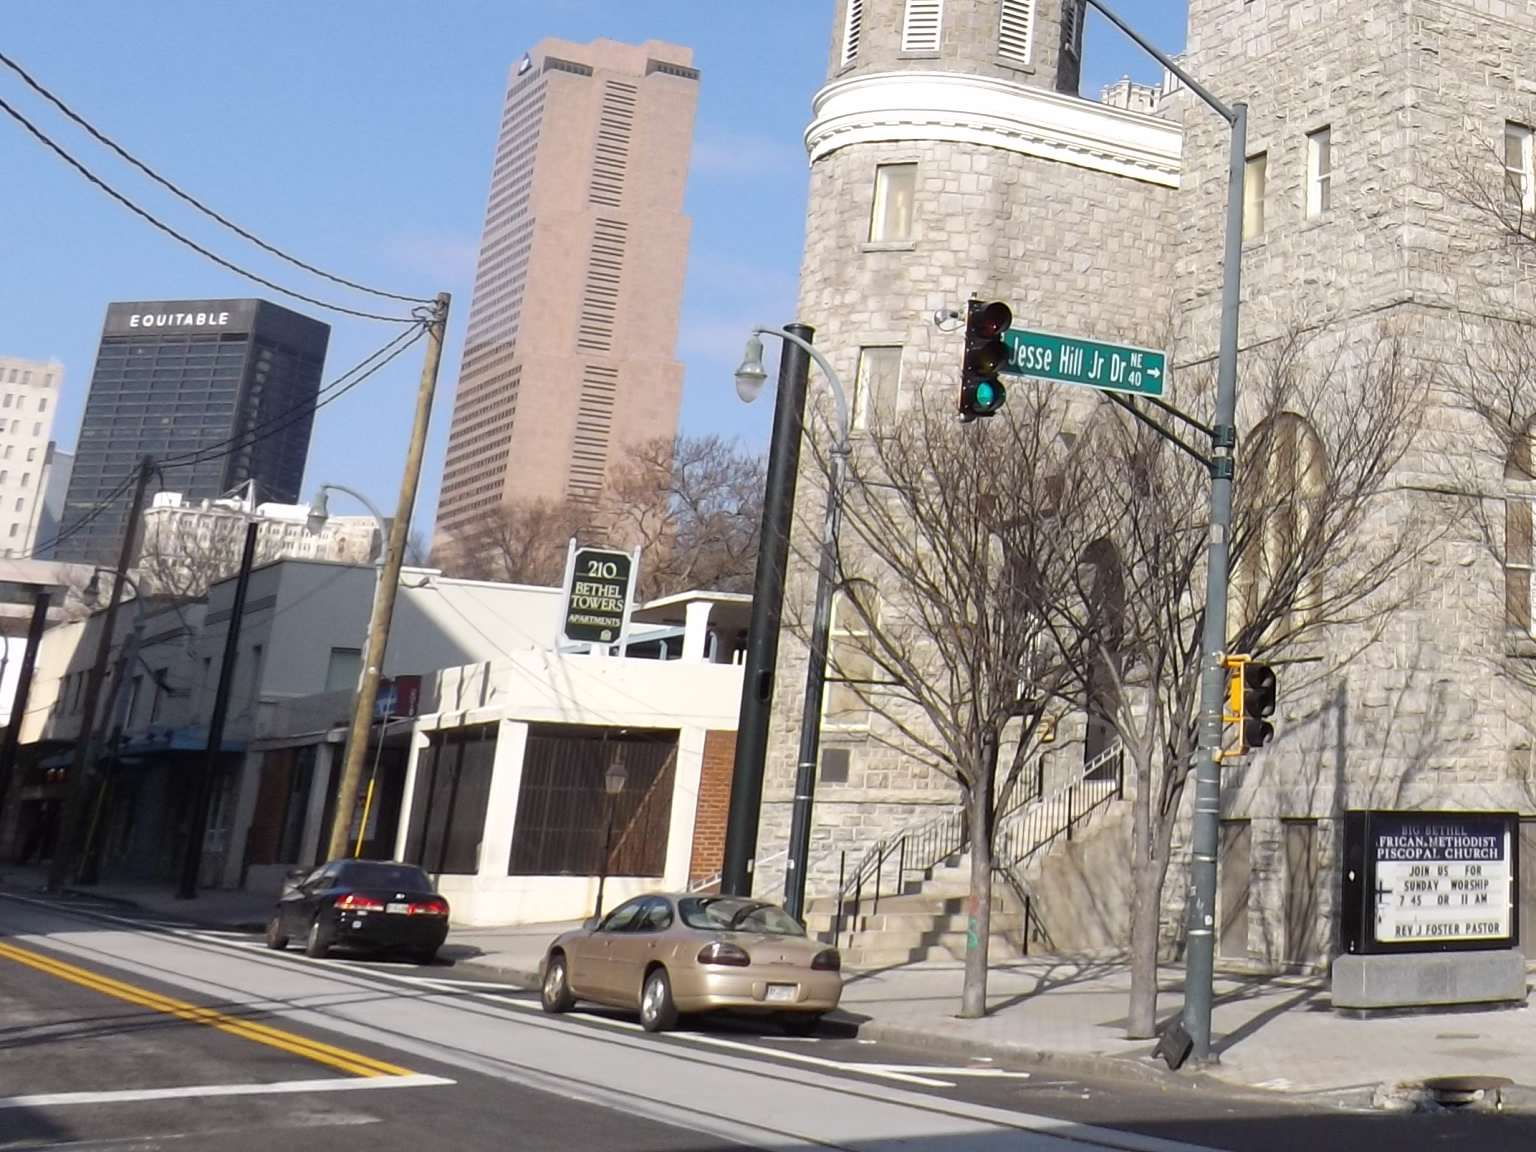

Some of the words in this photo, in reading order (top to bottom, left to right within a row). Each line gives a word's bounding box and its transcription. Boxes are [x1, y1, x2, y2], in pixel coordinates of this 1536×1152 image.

[130, 312, 229, 327] EQUITABLE
[1008, 336, 1052, 371] Jesse
[1058, 344, 1084, 377] Hill
[1087, 350, 1105, 380] Jr
[1110, 353, 1127, 383] Dr
[1130, 351, 1143, 369] NE
[1128, 370, 1142, 387] 40
[587, 560, 617, 579] 210
[575, 582, 621, 598] BETHEL
[571, 595, 624, 612] TOWERS
[568, 614, 620, 627] APARTMENTS
[1401, 825, 1420, 836] BIG
[1425, 825, 1468, 836] BETHEL
[1375, 836, 1424, 848] FRICAN
[1428, 836, 1497, 848] METHODIST
[1376, 847, 1441, 859] PISCOPAL
[1444, 847, 1498, 859] CHURCH
[1409, 865, 1430, 877] JOIN
[1437, 865, 1449, 876] US
[1464, 865, 1482, 876] FOR
[1404, 880, 1439, 892] SUNDAY
[1450, 879, 1490, 891] WORSHIP
[1399, 895, 1405, 906] 7
[1410, 895, 1422, 906] 45
[1437, 894, 1450, 905] OR
[1474, 894, 1488, 904] AM
[1395, 925, 1413, 937] REV
[1416, 925, 1422, 936] J
[1426, 923, 1460, 936] FOSTER
[1465, 922, 1500, 935] PASTOR
